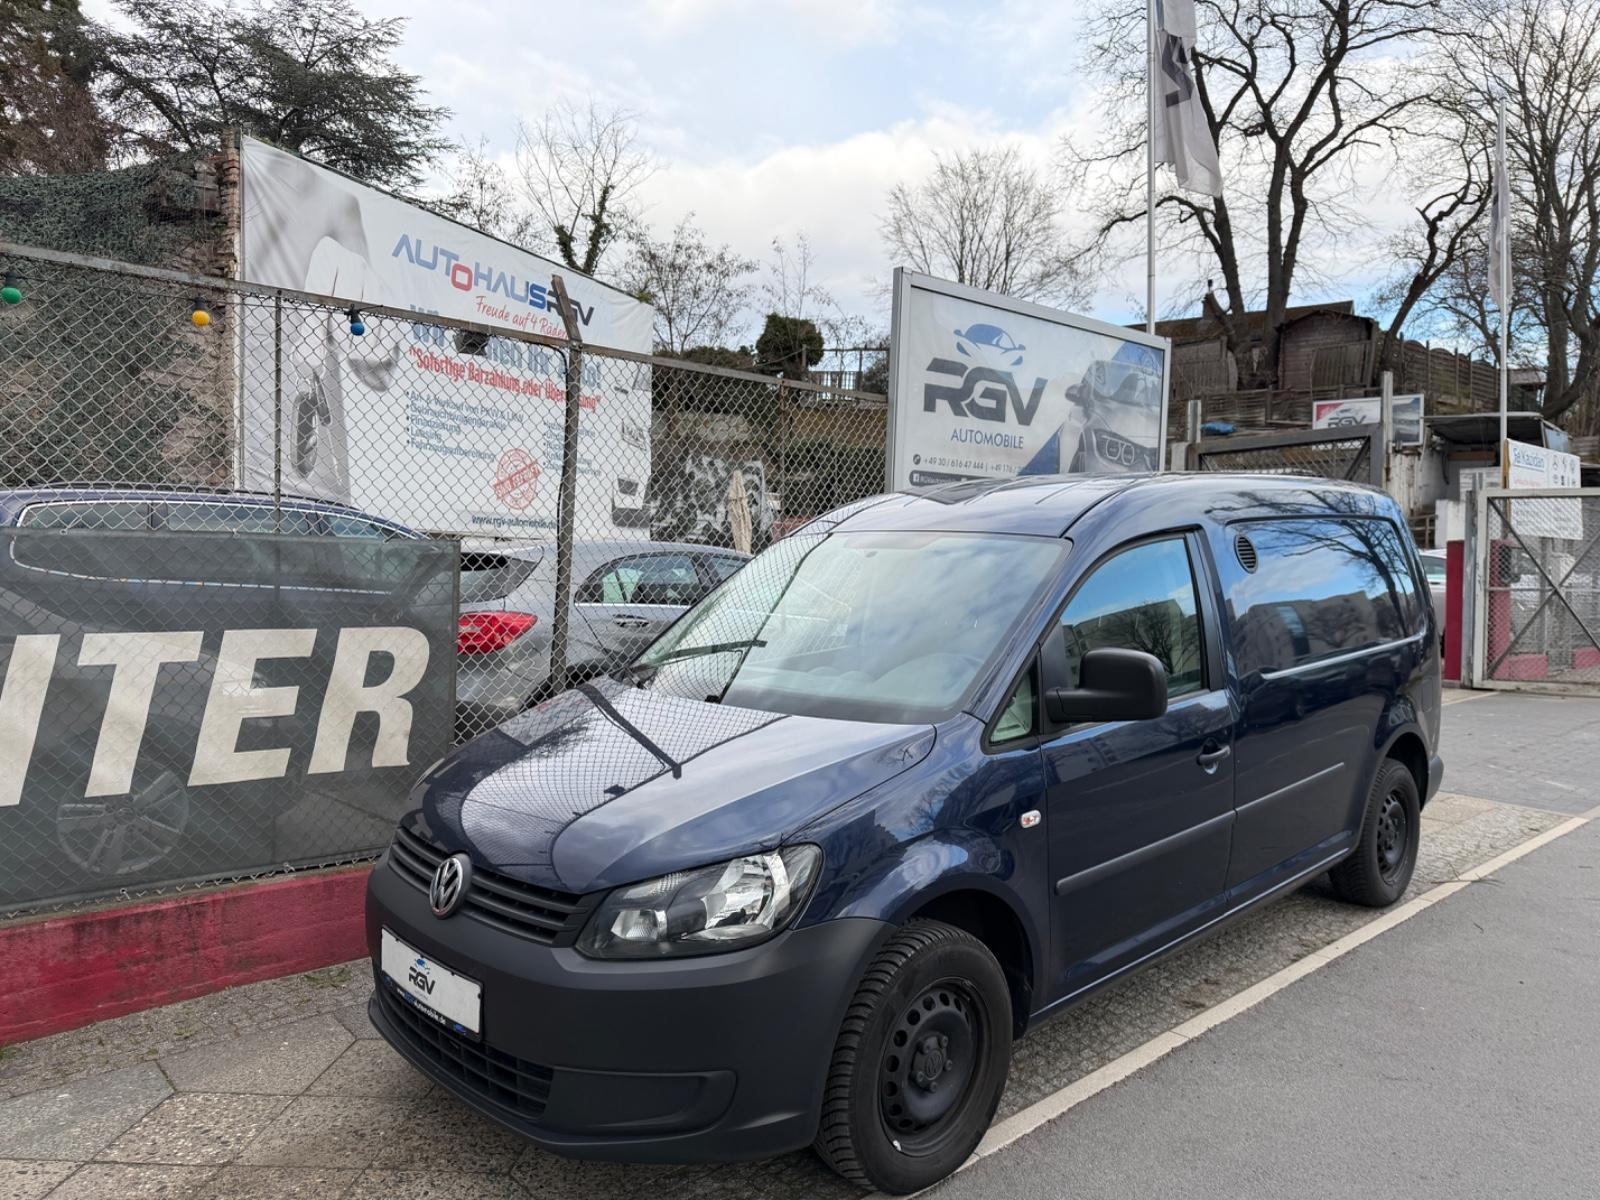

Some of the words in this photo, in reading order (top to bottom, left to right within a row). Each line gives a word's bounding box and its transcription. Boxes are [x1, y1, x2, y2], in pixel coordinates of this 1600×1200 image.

[475, 294, 510, 321] Freude
[512, 311, 531, 330] auf
[530, 314, 538, 330] 4
[547, 290, 594, 327] RV
[923, 356, 1049, 427] RGV
[950, 428, 1025, 449] AUTOMOBILE
[0, 626, 431, 807] ITER
[408, 965, 436, 996] RGV
